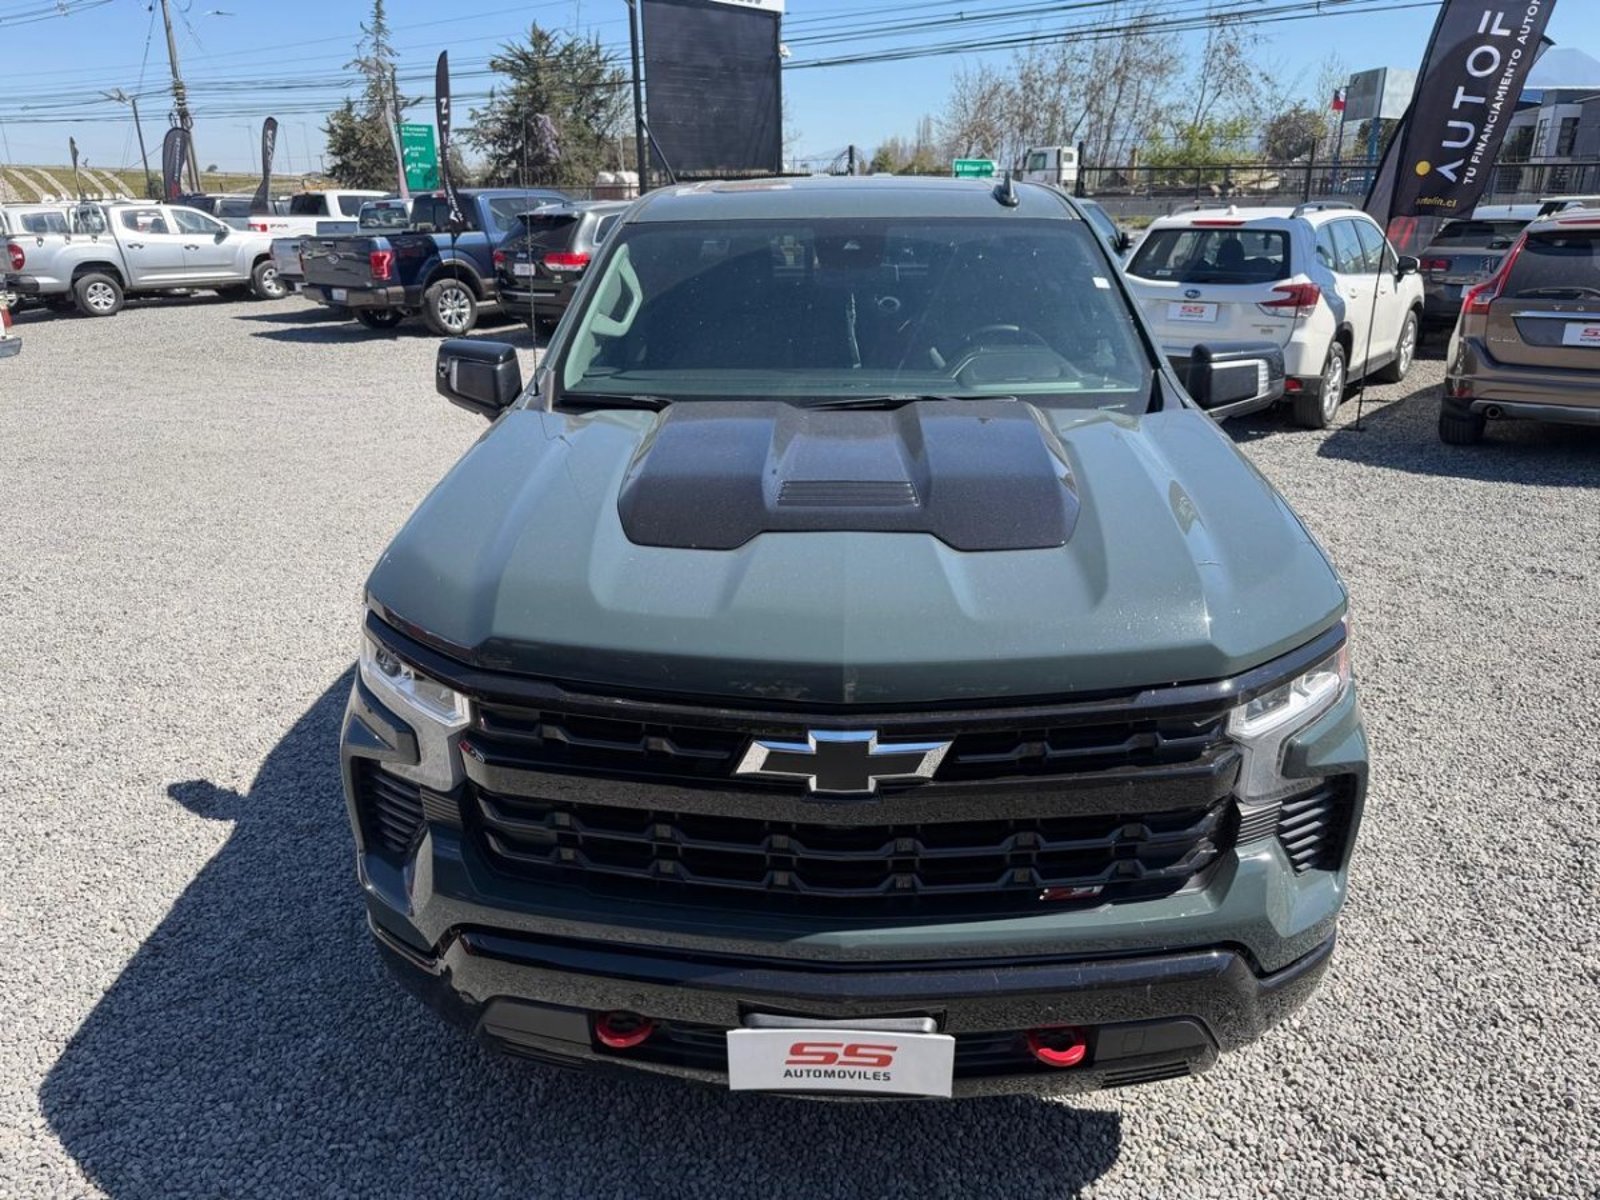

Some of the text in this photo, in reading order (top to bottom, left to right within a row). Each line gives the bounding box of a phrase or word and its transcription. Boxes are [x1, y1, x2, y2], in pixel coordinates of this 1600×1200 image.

[1463, 167, 1477, 184] TU
[1470, 49, 1522, 164] FINANCIAMIENTO
[785, 1042, 898, 1068] SS
[783, 1069, 891, 1081] AUTOMOVILES
